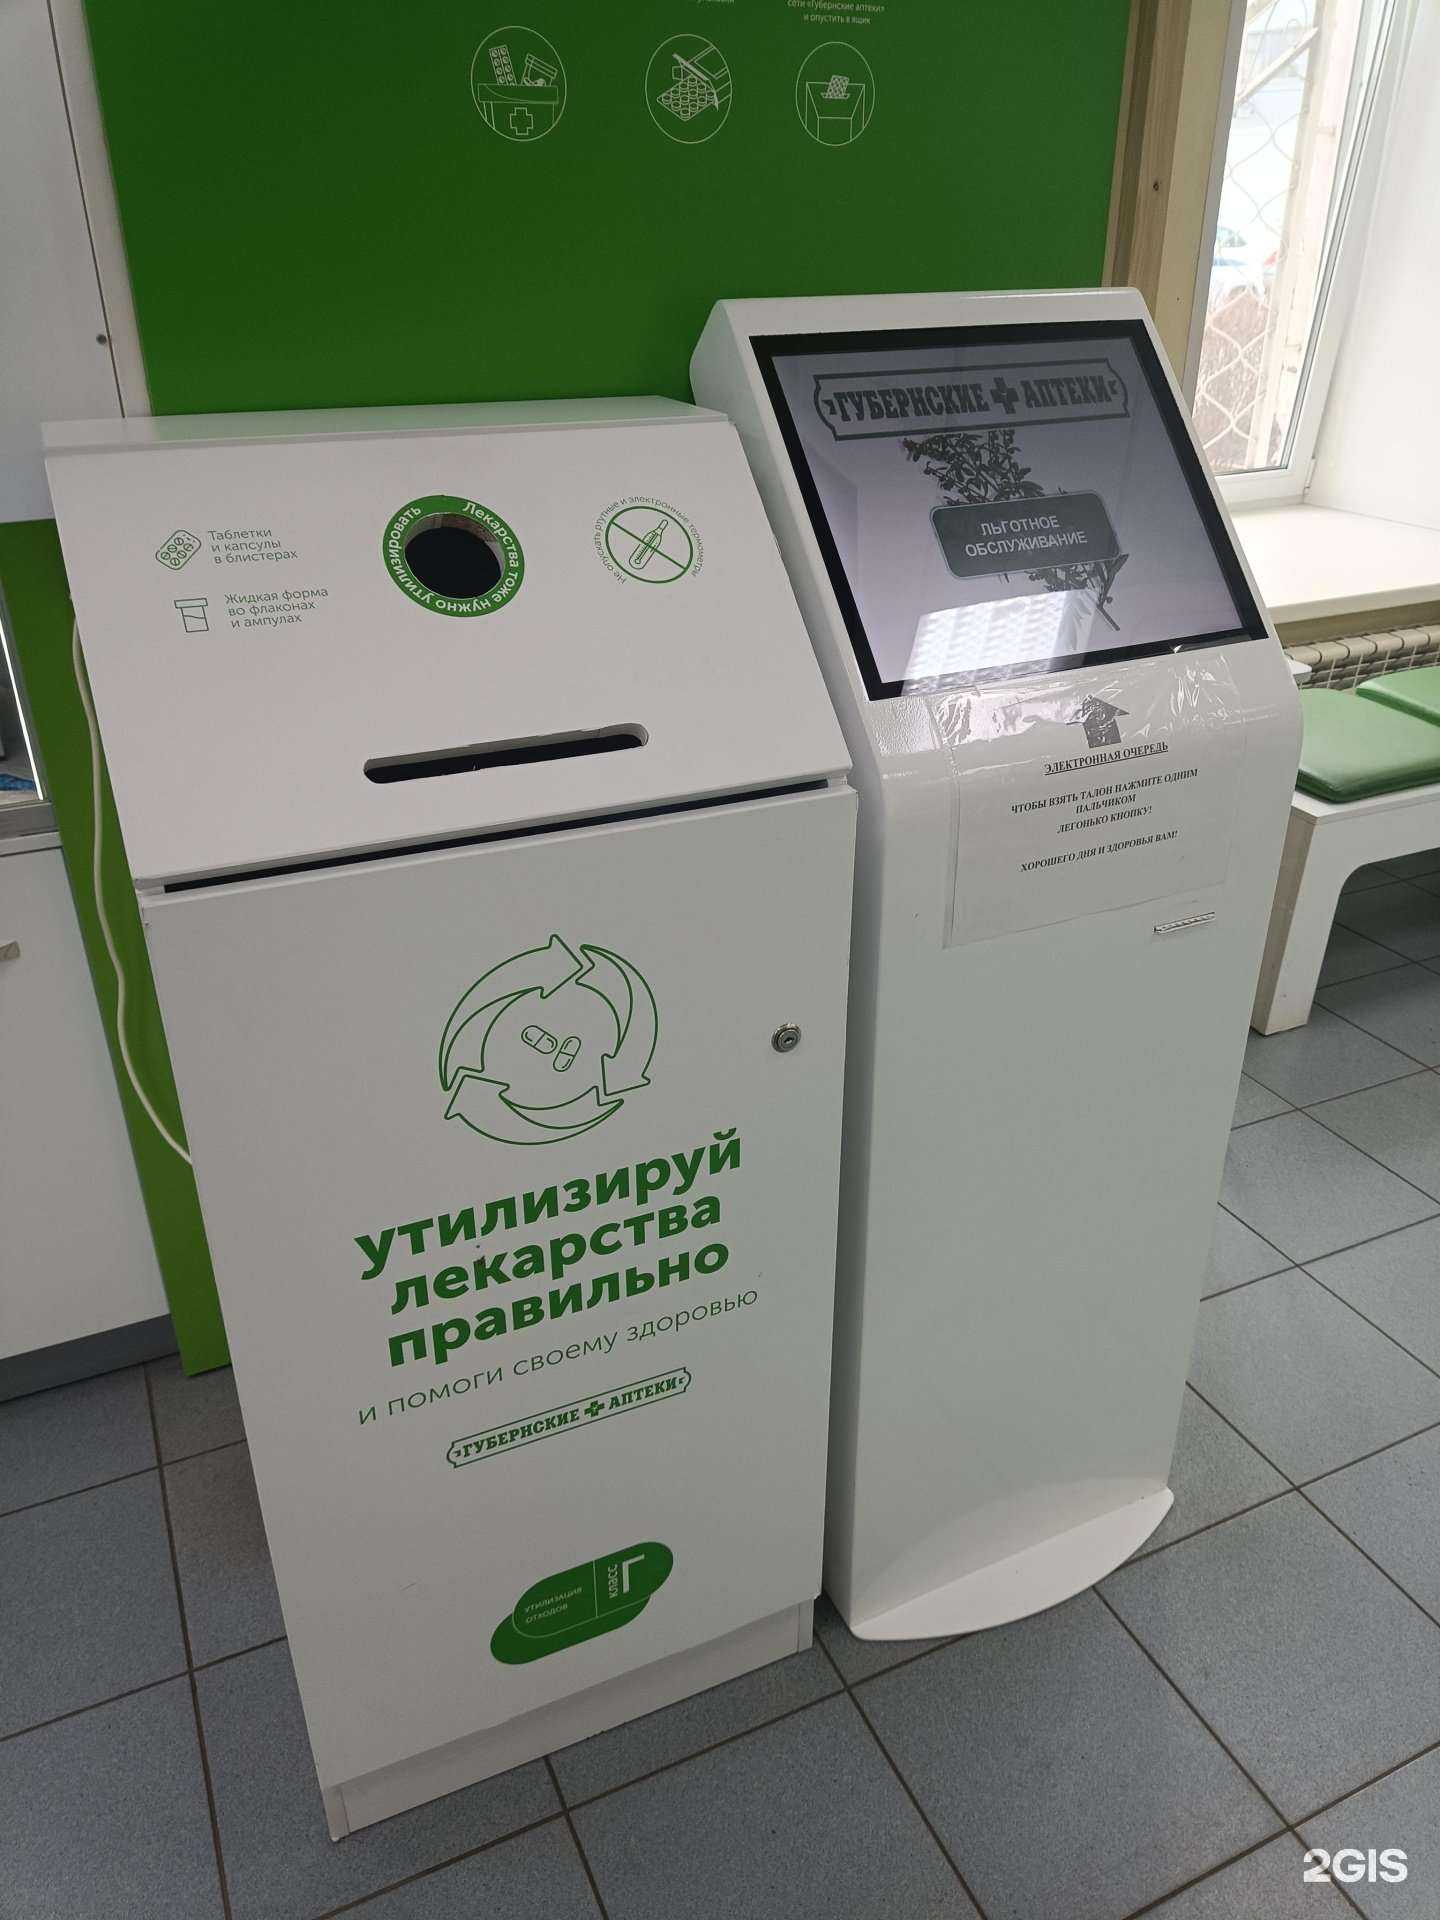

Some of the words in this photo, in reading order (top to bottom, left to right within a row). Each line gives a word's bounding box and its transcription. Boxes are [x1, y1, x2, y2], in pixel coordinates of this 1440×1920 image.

[810, 14, 844, 24] опустить
[833, 383, 990, 422] ГУБЕРНСКИЕ
[1020, 375, 1113, 409] АПТЕКИ
[208, 528, 272, 541] Таблетки
[462, 502, 519, 567] Лекарства
[981, 515, 1060, 536] ЛЬГОТНОЕ
[211, 544, 220, 553] и
[224, 540, 281, 552] капсулы
[214, 555, 222, 564] в
[226, 550, 298, 564] блистерах
[389, 507, 434, 603] утилизировать
[965, 531, 1088, 557] ОБСЛУЖИВАНИЕ
[224, 593, 279, 605] Жидкая
[282, 588, 329, 601] форма
[492, 571, 518, 602] тоже
[228, 607, 245, 617] во
[248, 601, 316, 616] флаконах
[436, 599, 491, 612] нужно
[231, 619, 240, 629] и
[244, 614, 302, 628] ампулах
[1044, 751, 1121, 774] ЭЛЕКТРОННАЯ
[1123, 742, 1169, 758] ОЧЕРЕДЬ
[1011, 799, 1047, 814] ЧТОБЫ
[1049, 793, 1078, 807] ВЗЯТЬ
[1080, 786, 1113, 801] ТАЛОН
[1115, 776, 1163, 793] НАЖМИТЕ
[1164, 768, 1198, 783] ОДНИМ
[1075, 794, 1136, 814] ПАЛЬЧИКОМ
[1057, 813, 1109, 834] ЛЕГОНЬКО
[1110, 806, 1152, 823] КНОПКУ!
[1019, 853, 1076, 872] ХОРОШЕГО
[1077, 848, 1097, 861] ДНЯ
[1098, 846, 1105, 855] И
[1106, 836, 1153, 854] ЗДОРОВЬЯ
[1155, 830, 1179, 843] ВАМ!
[353, 1127, 742, 1281] утилизируй
[391, 1195, 721, 1315] лекарства
[388, 1243, 730, 1367] правильно
[388, 1367, 502, 1416] помоги
[513, 1332, 618, 1377] своему
[627, 1290, 758, 1344] здоровью
[462, 1408, 580, 1459] ГУБЕРНСКИЕ
[609, 1377, 678, 1410] АПТЕКИ
[622, 1554, 645, 1594] Г
